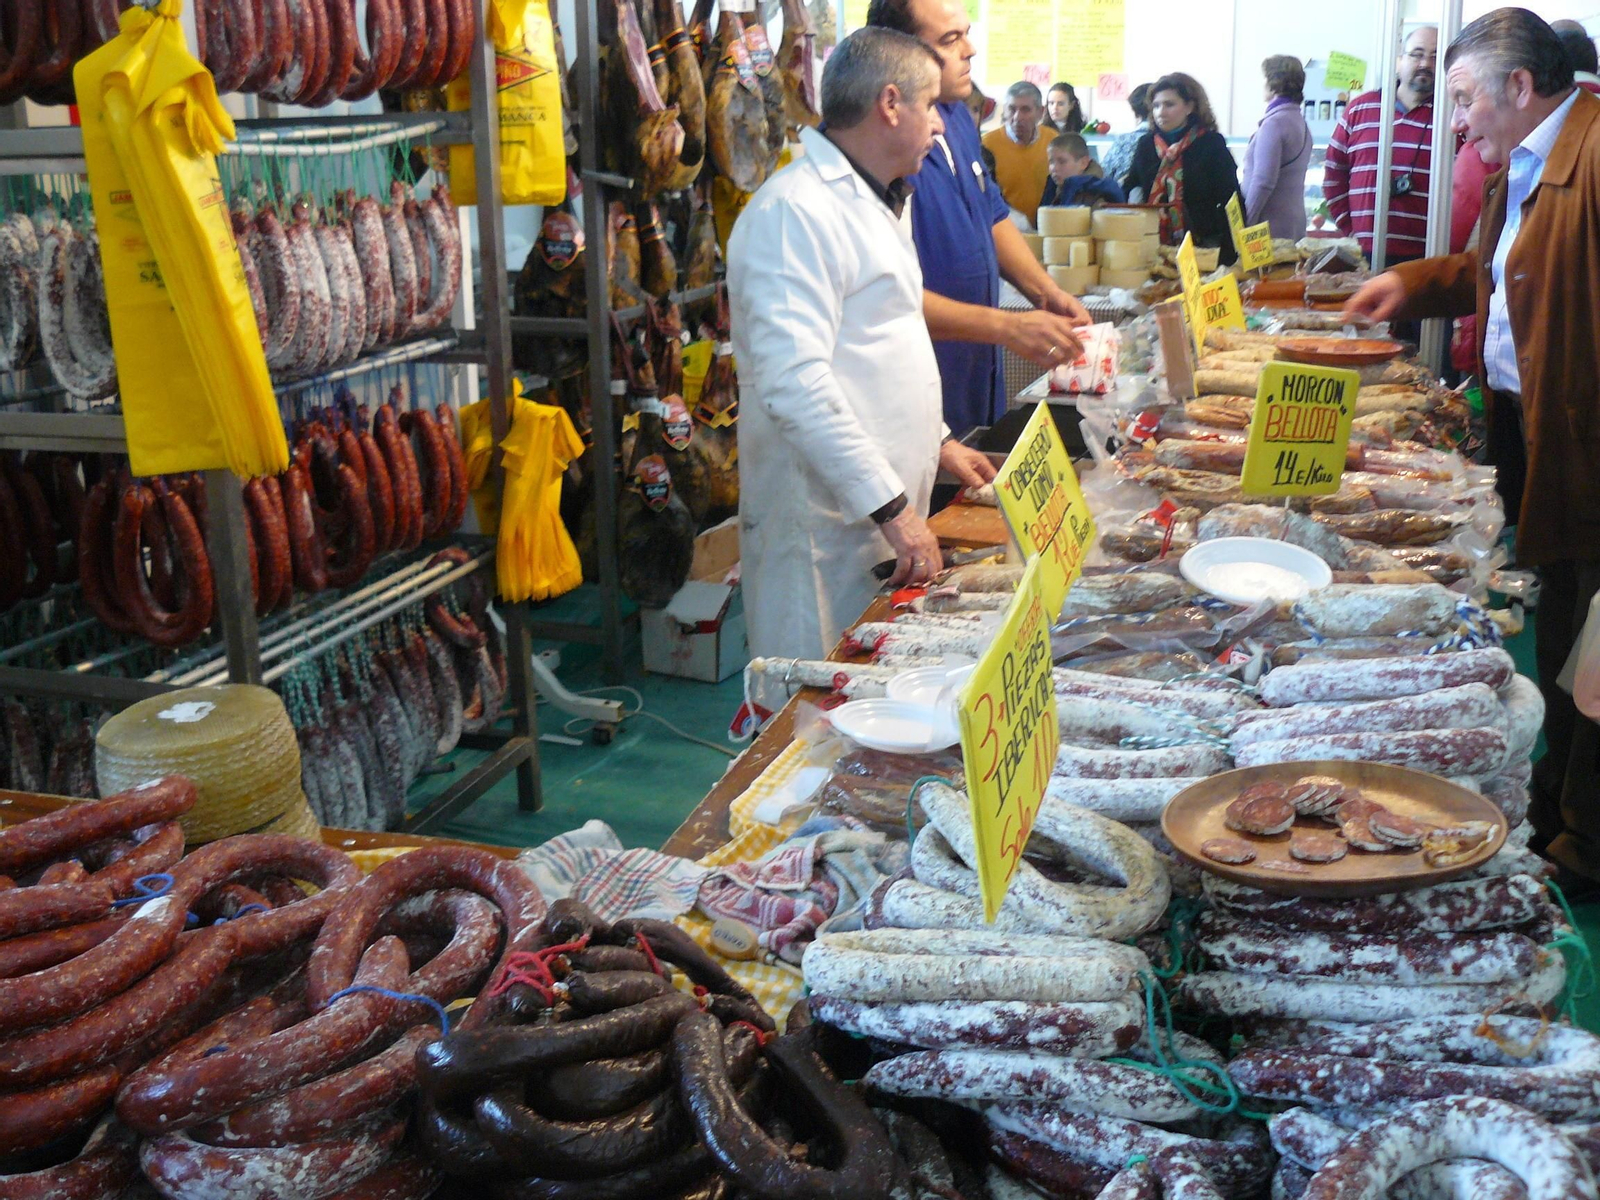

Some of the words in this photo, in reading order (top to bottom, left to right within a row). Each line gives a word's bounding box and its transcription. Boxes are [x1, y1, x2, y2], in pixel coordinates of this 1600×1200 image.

[1264, 404, 1339, 440] BELLOTA
[1281, 374, 1345, 404] MORCON
[1008, 424, 1052, 501] CABECERO
[1029, 483, 1069, 552] BELLOTA
[974, 693, 999, 783] 3
